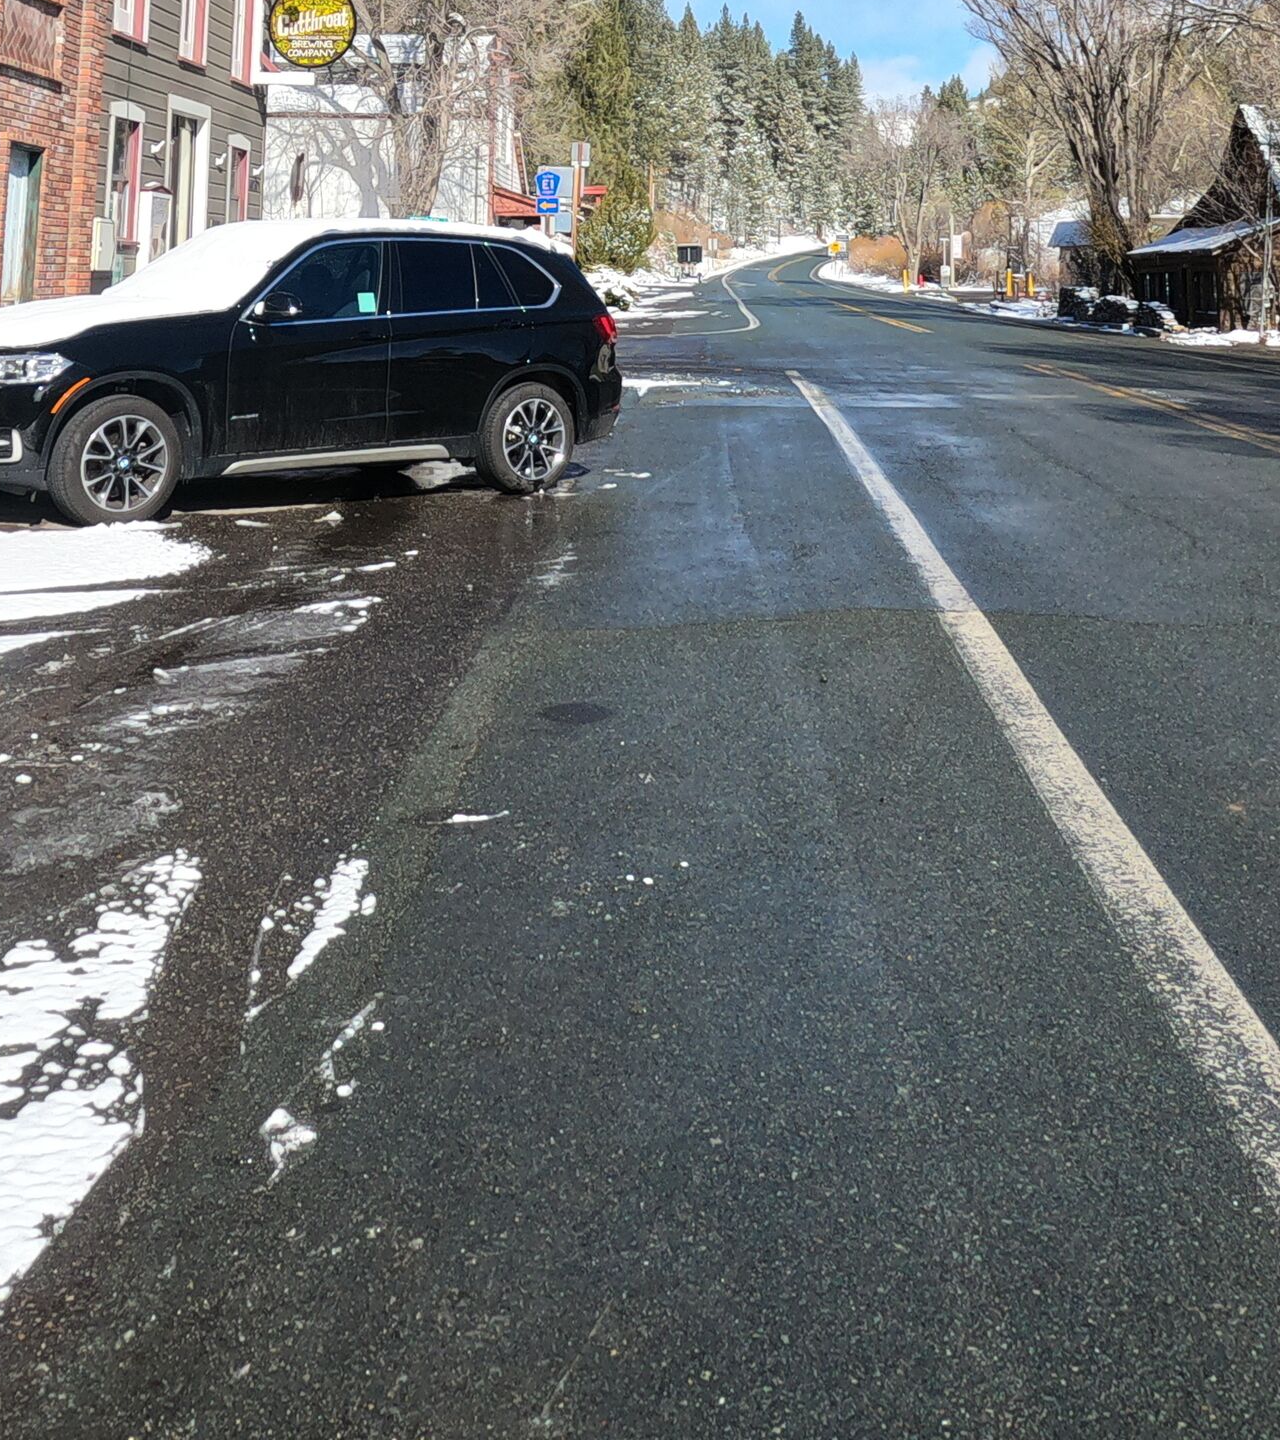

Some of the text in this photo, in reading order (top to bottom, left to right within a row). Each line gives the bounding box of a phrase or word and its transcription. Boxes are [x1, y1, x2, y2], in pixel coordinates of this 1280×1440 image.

[277, 7, 349, 37] Cutthroat
[291, 40, 333, 49] BREWING
[287, 48, 336, 58] COMPANY
